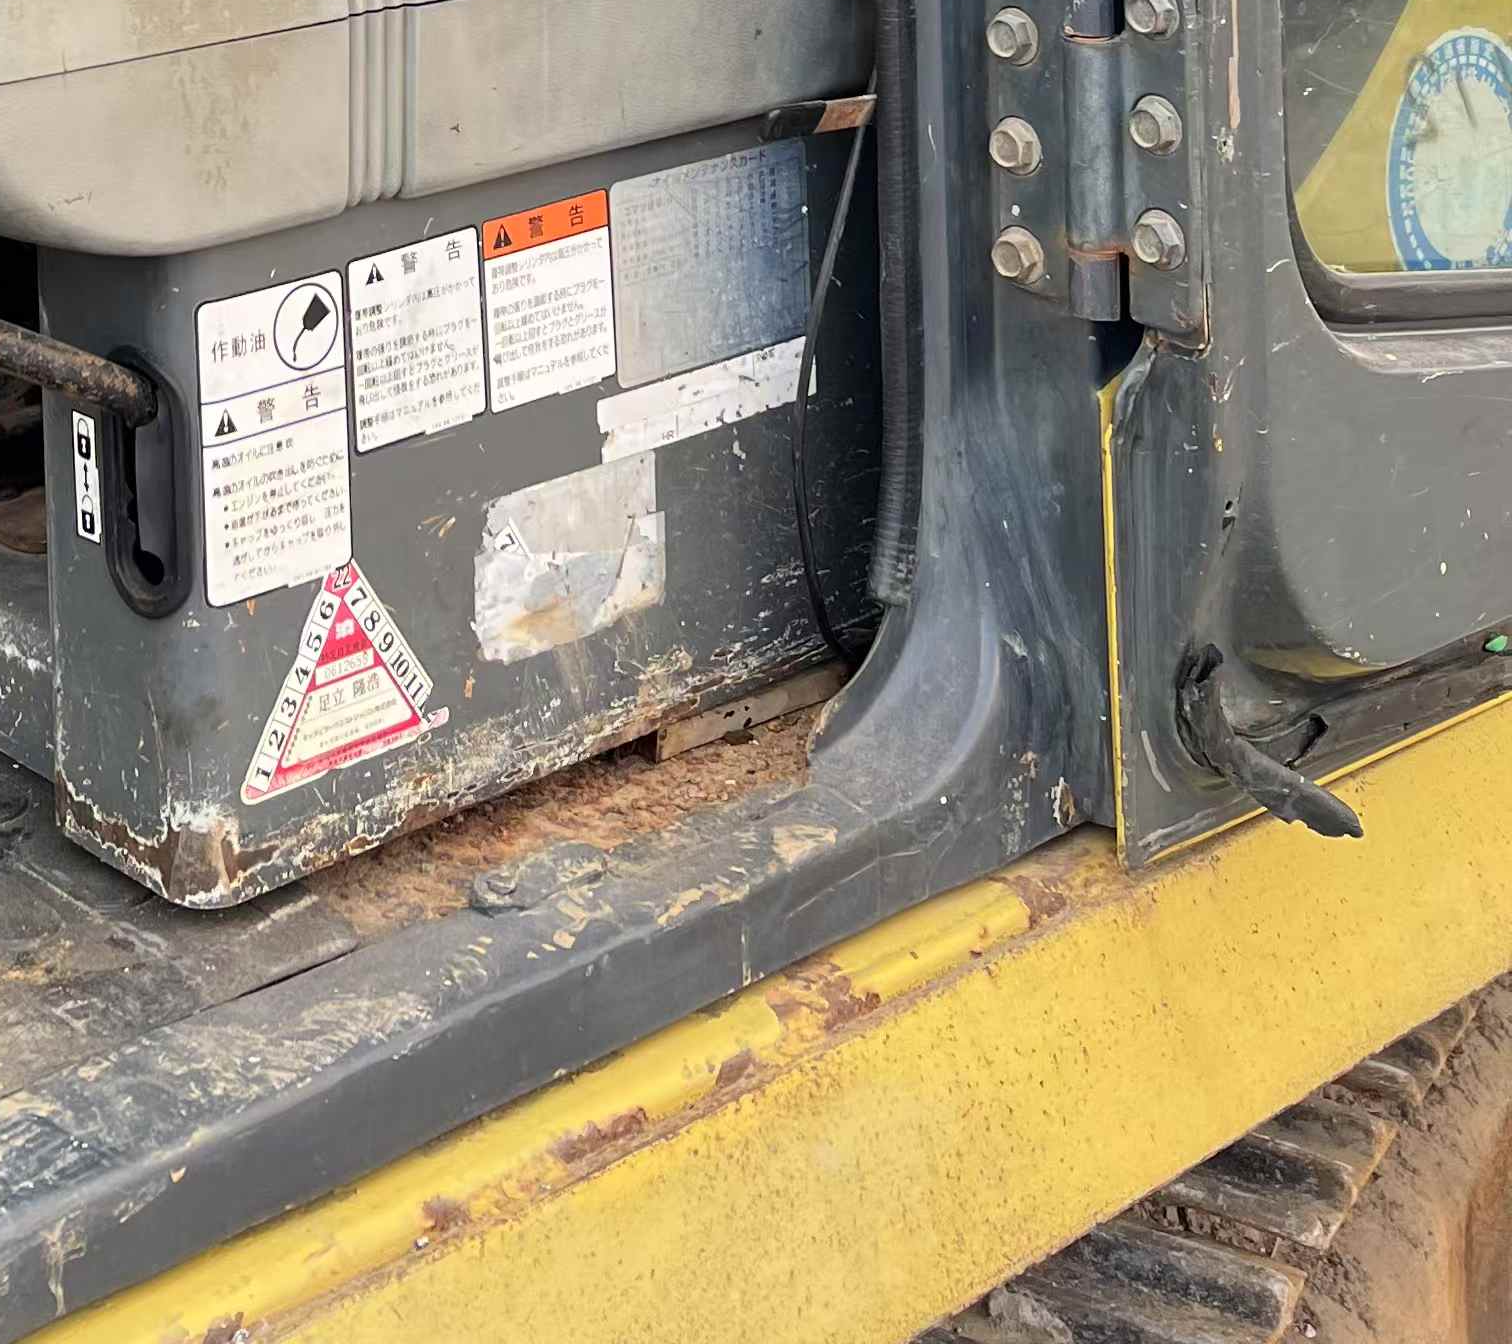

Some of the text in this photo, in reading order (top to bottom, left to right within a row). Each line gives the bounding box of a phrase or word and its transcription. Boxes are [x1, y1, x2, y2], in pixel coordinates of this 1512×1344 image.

[527, 201, 584, 239] 警告
[399, 236, 463, 276] 警告
[211, 330, 266, 364] 作動油
[256, 382, 321, 426] 警告
[334, 566, 351, 589] 22
[350, 588, 422, 698] 7 8 9 10 11
[256, 767, 270, 779] 1
[269, 731, 285, 750] 2
[281, 699, 297, 718] 3
[294, 667, 311, 683] 4
[307, 633, 323, 652] 5
[319, 602, 336, 618] 6
